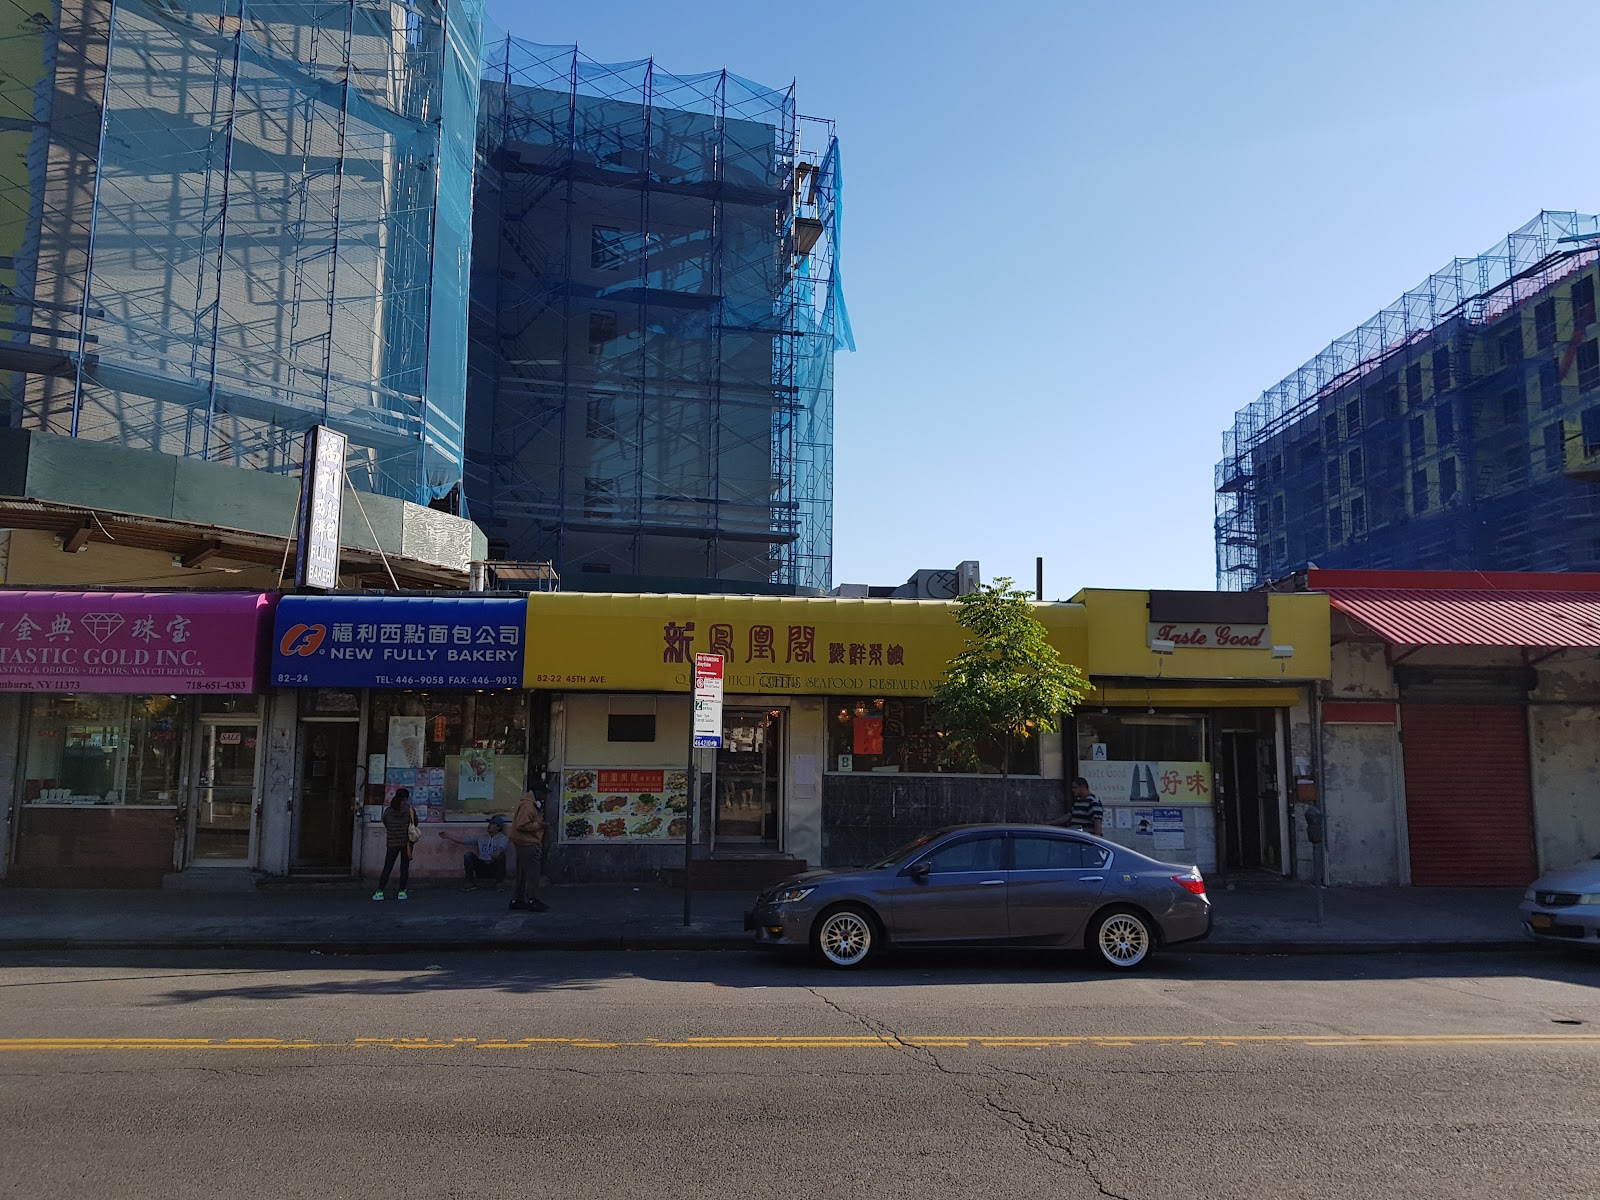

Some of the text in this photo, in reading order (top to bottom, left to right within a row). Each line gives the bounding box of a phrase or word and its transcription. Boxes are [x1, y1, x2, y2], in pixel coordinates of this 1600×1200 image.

[310, 544, 336, 564] FULLY
[308, 565, 335, 583] BAKERY
[0, 612, 192, 644] 金典 珠宝
[331, 622, 520, 645] 福利西點面包公司
[1156, 624, 1266, 646] Taste Good
[83, 648, 150, 665] GOLD
[155, 649, 202, 666] INC.
[330, 647, 519, 662] NEW FULLY BAKERY
[42, 666, 80, 674] ORDERS
[132, 667, 165, 675] WATCH
[168, 668, 206, 676] REPAIRS
[277, 673, 309, 683] 82-24
[375, 675, 518, 685] TEL: 446-9058 FAX: 446-9812
[536, 674, 607, 684] 82-22 45TH AVE.
[805, 676, 864, 690] SEAFOOD
[36, 681, 52, 689] NY
[54, 681, 80, 690] 11373
[186, 681, 246, 690] 718-651-4383
[220, 733, 240, 741] SALE
[1095, 745, 1105, 756] A
[841, 756, 850, 768] B
[1091, 782, 1125, 791] alaysia
[1160, 769, 1209, 796] 好味
